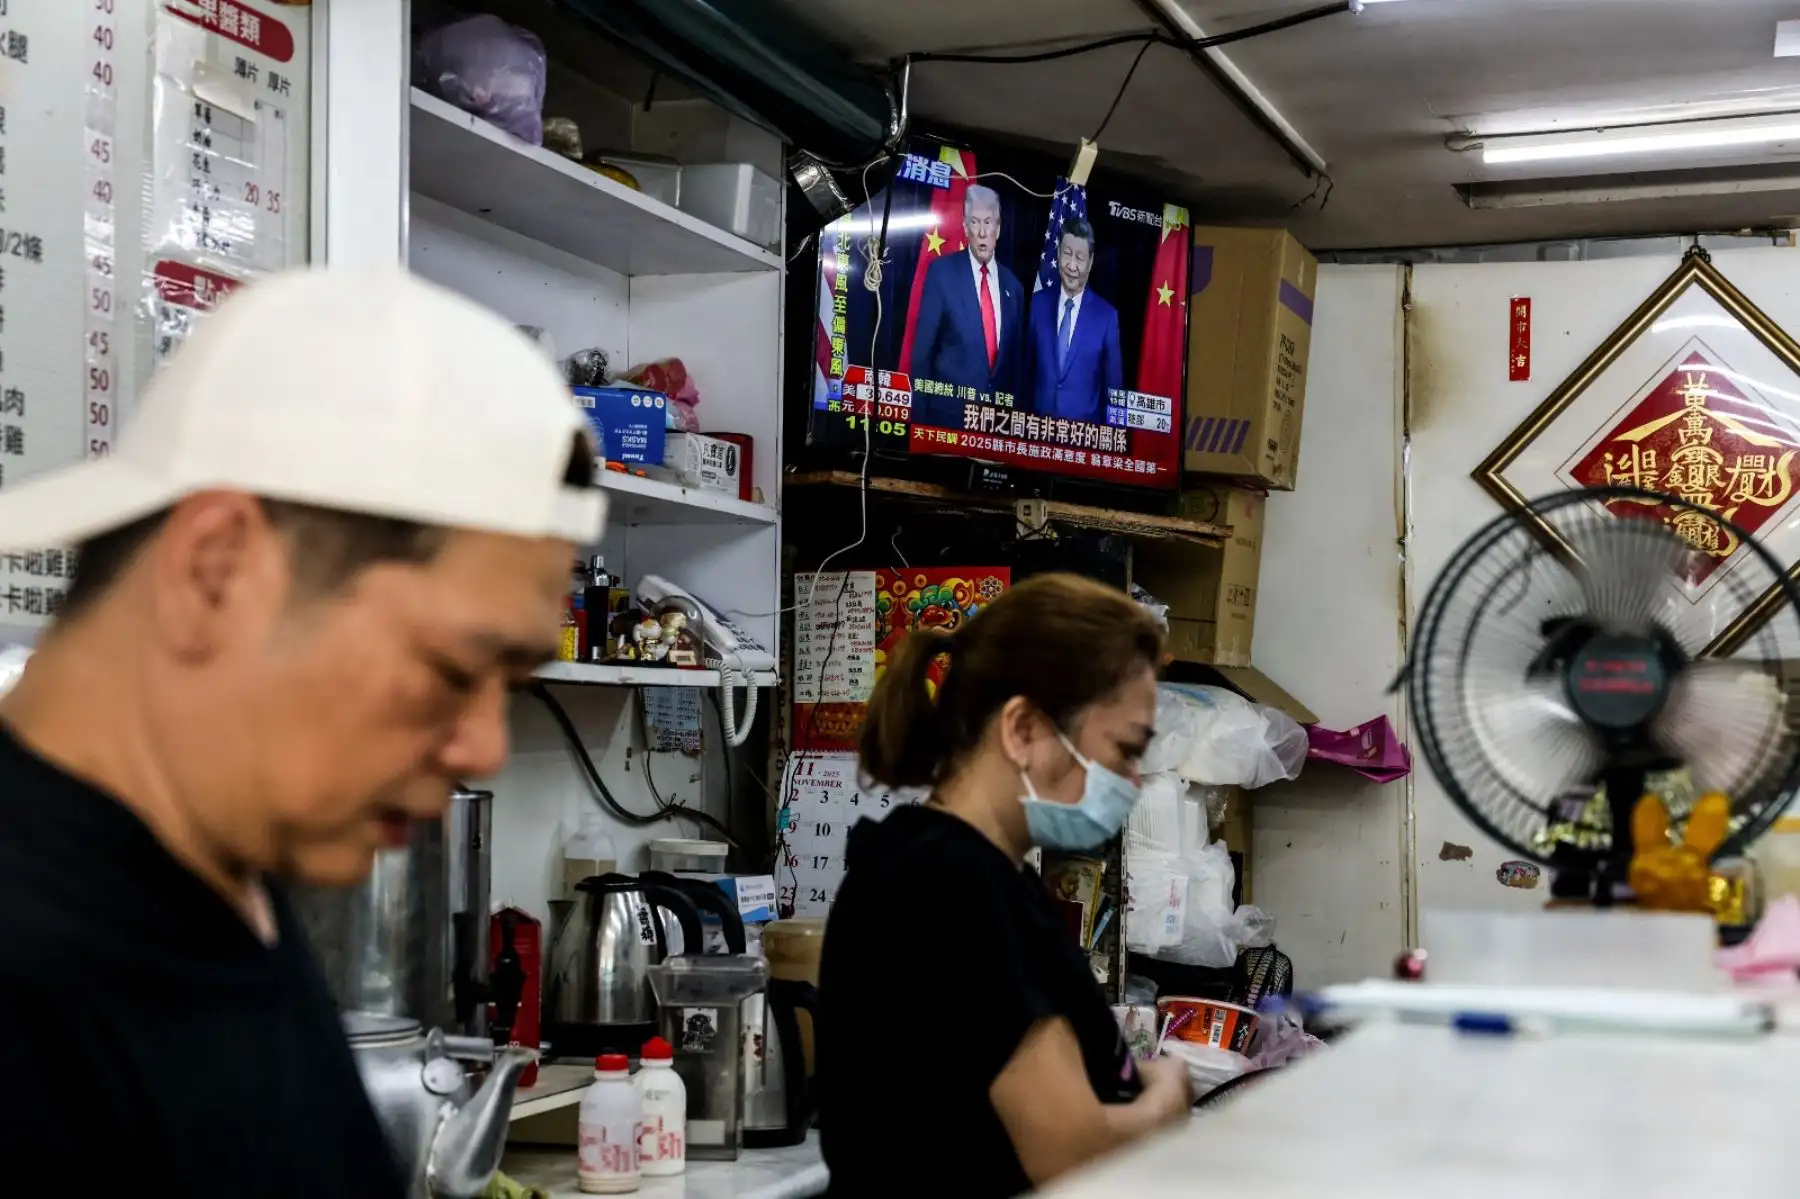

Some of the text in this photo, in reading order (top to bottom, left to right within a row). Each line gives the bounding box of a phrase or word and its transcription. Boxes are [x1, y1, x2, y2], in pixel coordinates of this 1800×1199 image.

[93, 24, 113, 50] 40
[92, 61, 112, 86] 40
[90, 138, 110, 163] 45
[905, 153, 952, 188] 消息
[267, 190, 280, 213] 35
[92, 288, 111, 313] 50
[90, 367, 109, 392] 50
[865, 388, 910, 406] 3.649
[914, 378, 954, 397] 美國總統
[957, 385, 977, 401] 川普
[995, 391, 1014, 407] 記者
[1136, 396, 1166, 412] 高雄市
[90, 402, 109, 426] 50
[963, 404, 1128, 454] 我們之間有非常好的關係
[961, 434, 1086, 464] 2025縣市長施政滿意度
[1091, 453, 1167, 474] 翁章梁全國第一
[820, 790, 829, 804] 3
[850, 793, 859, 806] 4
[880, 794, 890, 808] 5
[788, 821, 798, 833] 9
[815, 822, 831, 836] 10
[812, 855, 829, 870] 17
[809, 888, 826, 903] 24
